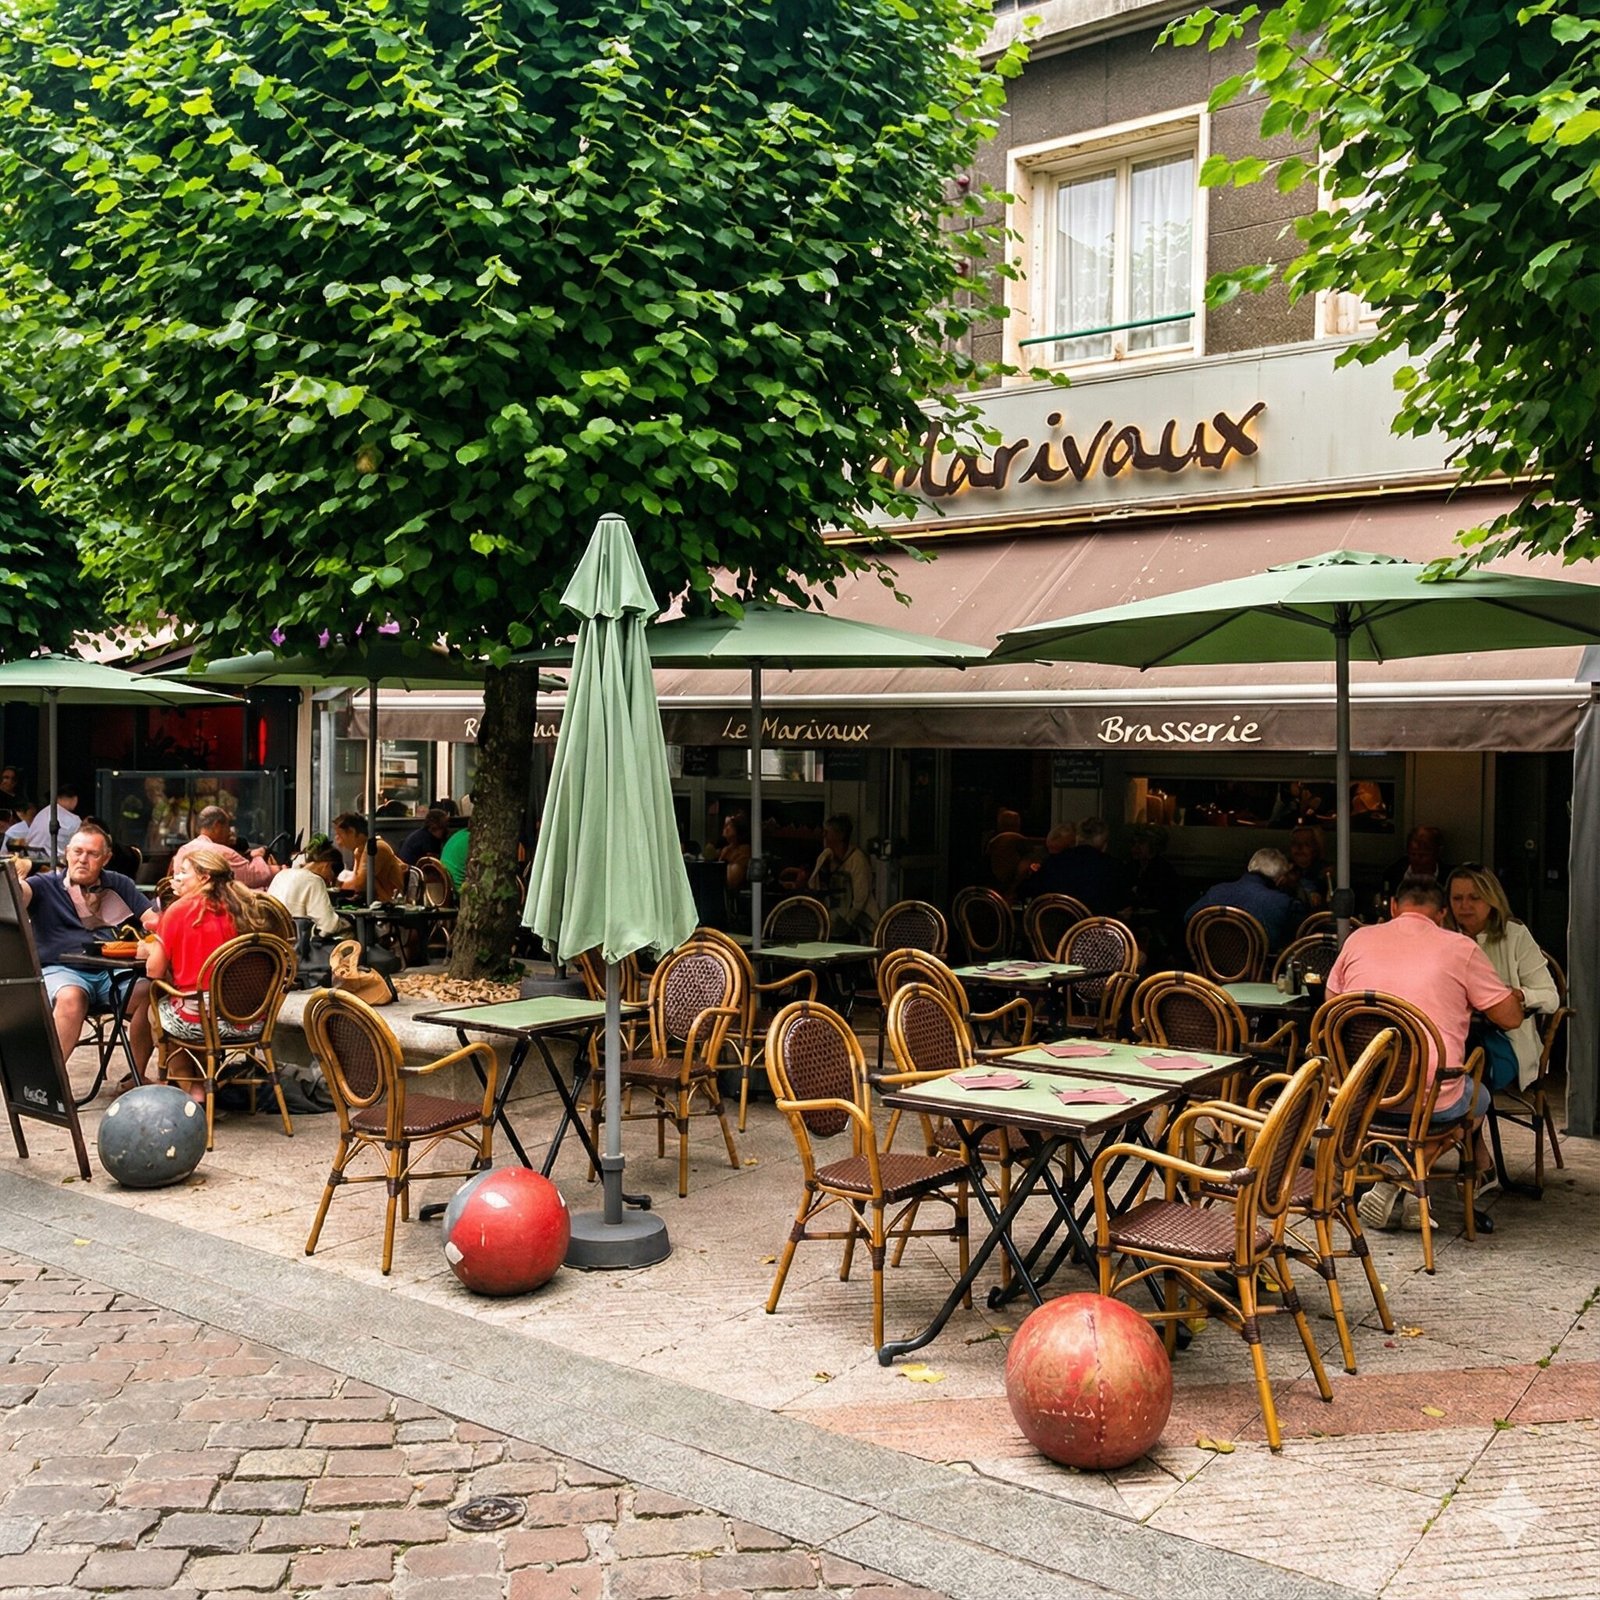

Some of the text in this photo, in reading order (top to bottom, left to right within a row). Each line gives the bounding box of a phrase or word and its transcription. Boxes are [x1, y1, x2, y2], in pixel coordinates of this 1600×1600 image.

[721, 716, 871, 742] Le Marivaux
[1097, 715, 1262, 743] Brasserie
